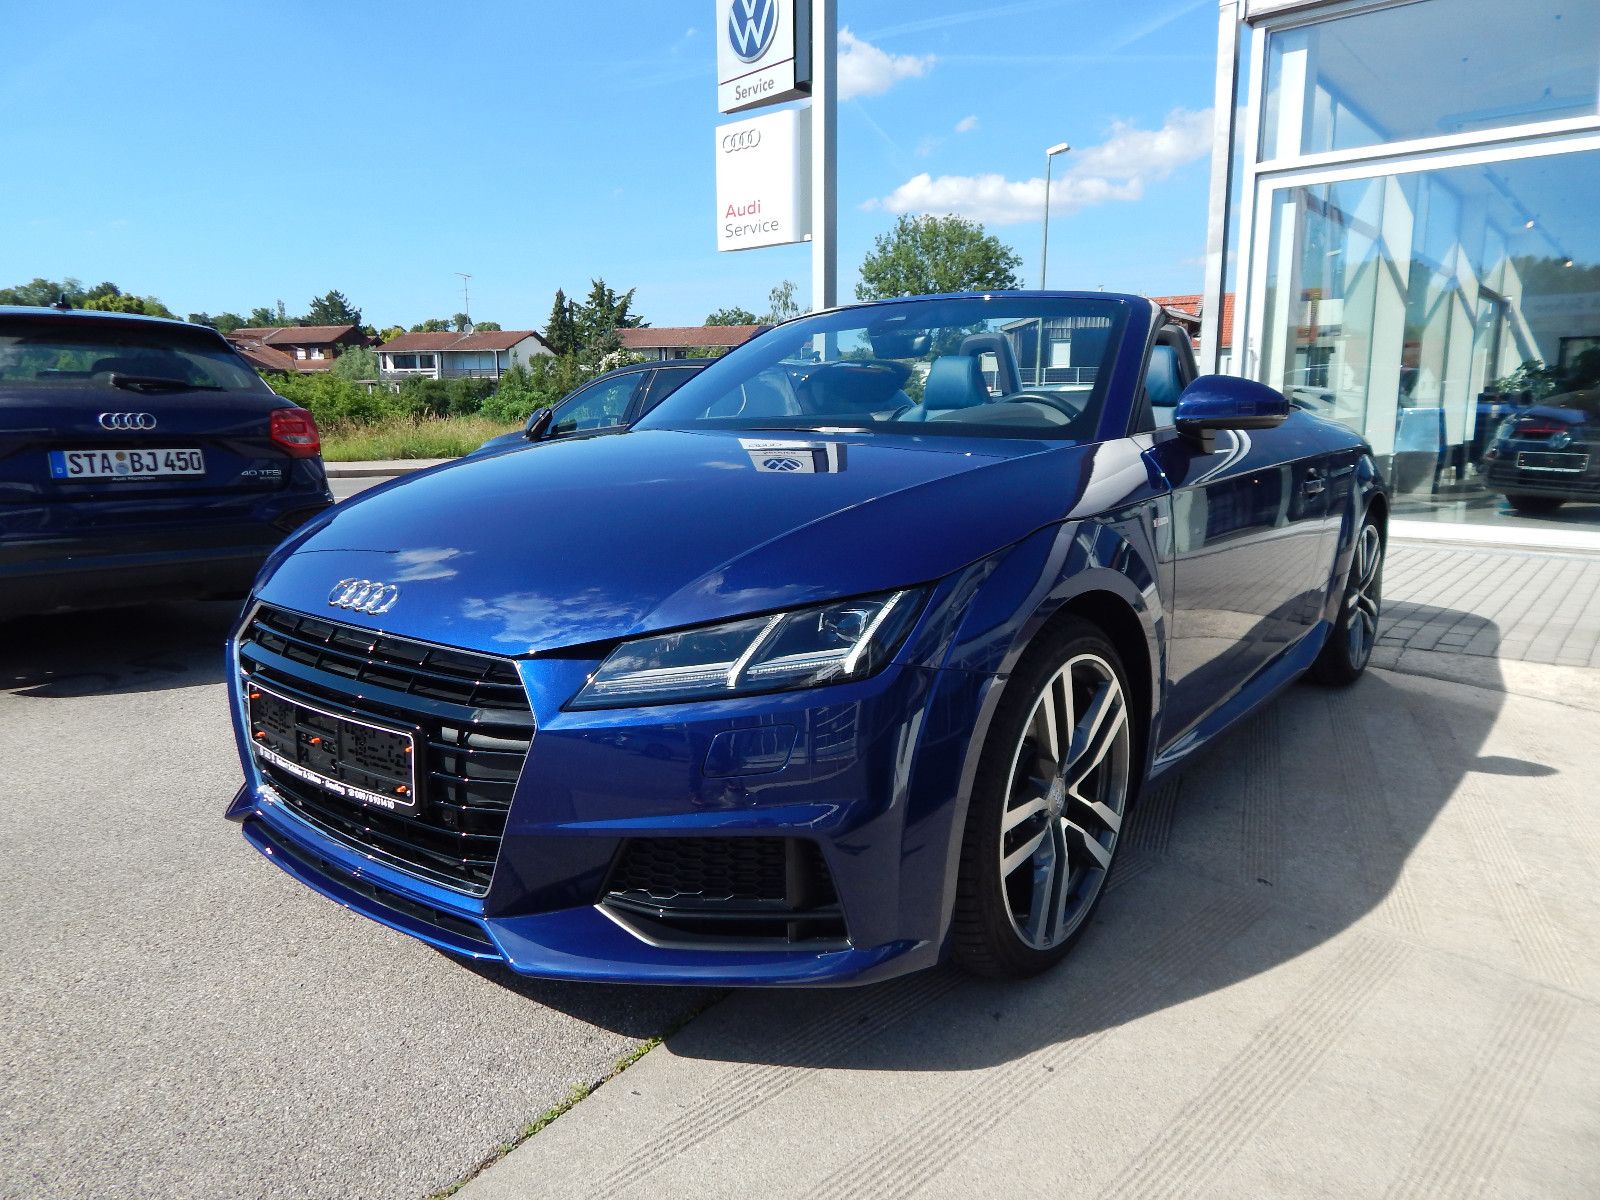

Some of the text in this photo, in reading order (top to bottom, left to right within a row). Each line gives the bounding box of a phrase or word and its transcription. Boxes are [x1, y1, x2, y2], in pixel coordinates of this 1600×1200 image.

[735, 78, 775, 101] Service
[725, 199, 762, 219] Audi
[725, 219, 780, 238] Service
[68, 452, 114, 475] STA
[129, 451, 159, 473] BJ
[164, 451, 202, 472] 450
[241, 469, 258, 477] 40
